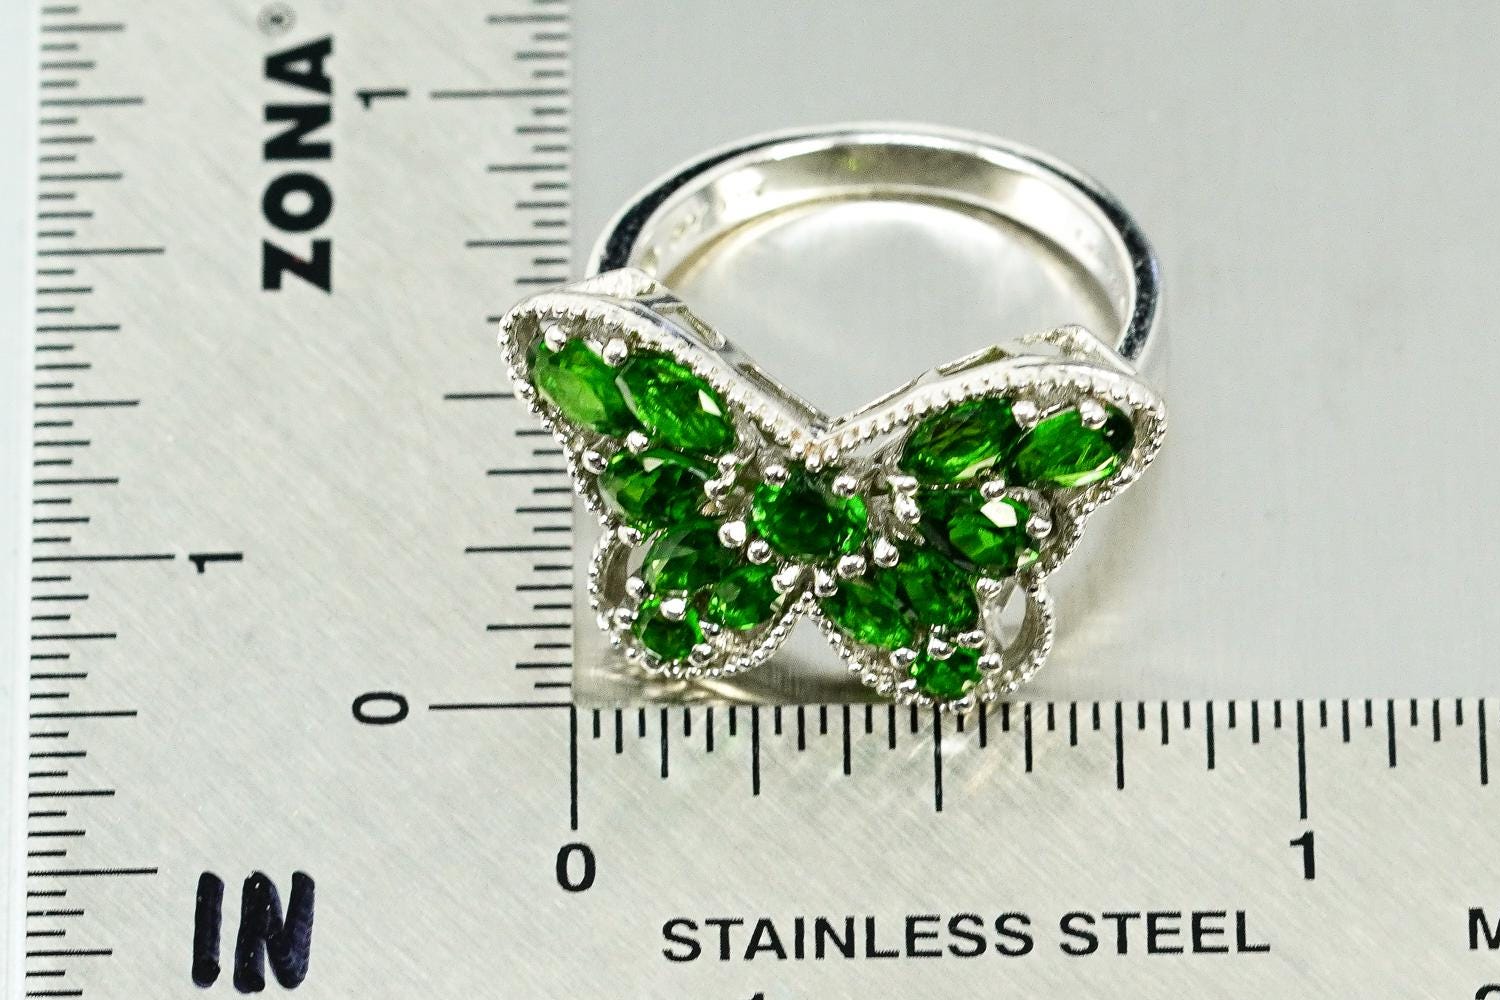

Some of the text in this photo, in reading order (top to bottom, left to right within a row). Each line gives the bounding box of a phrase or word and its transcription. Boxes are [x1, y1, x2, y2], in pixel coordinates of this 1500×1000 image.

[356, 89, 408, 108] 1
[188, 551, 244, 574] 1
[351, 691, 409, 726] 0
[555, 842, 597, 893] 0
[1289, 830, 1316, 881] 1
[191, 870, 316, 995] IN
[662, 910, 1271, 963] STAINLESS STEEL
